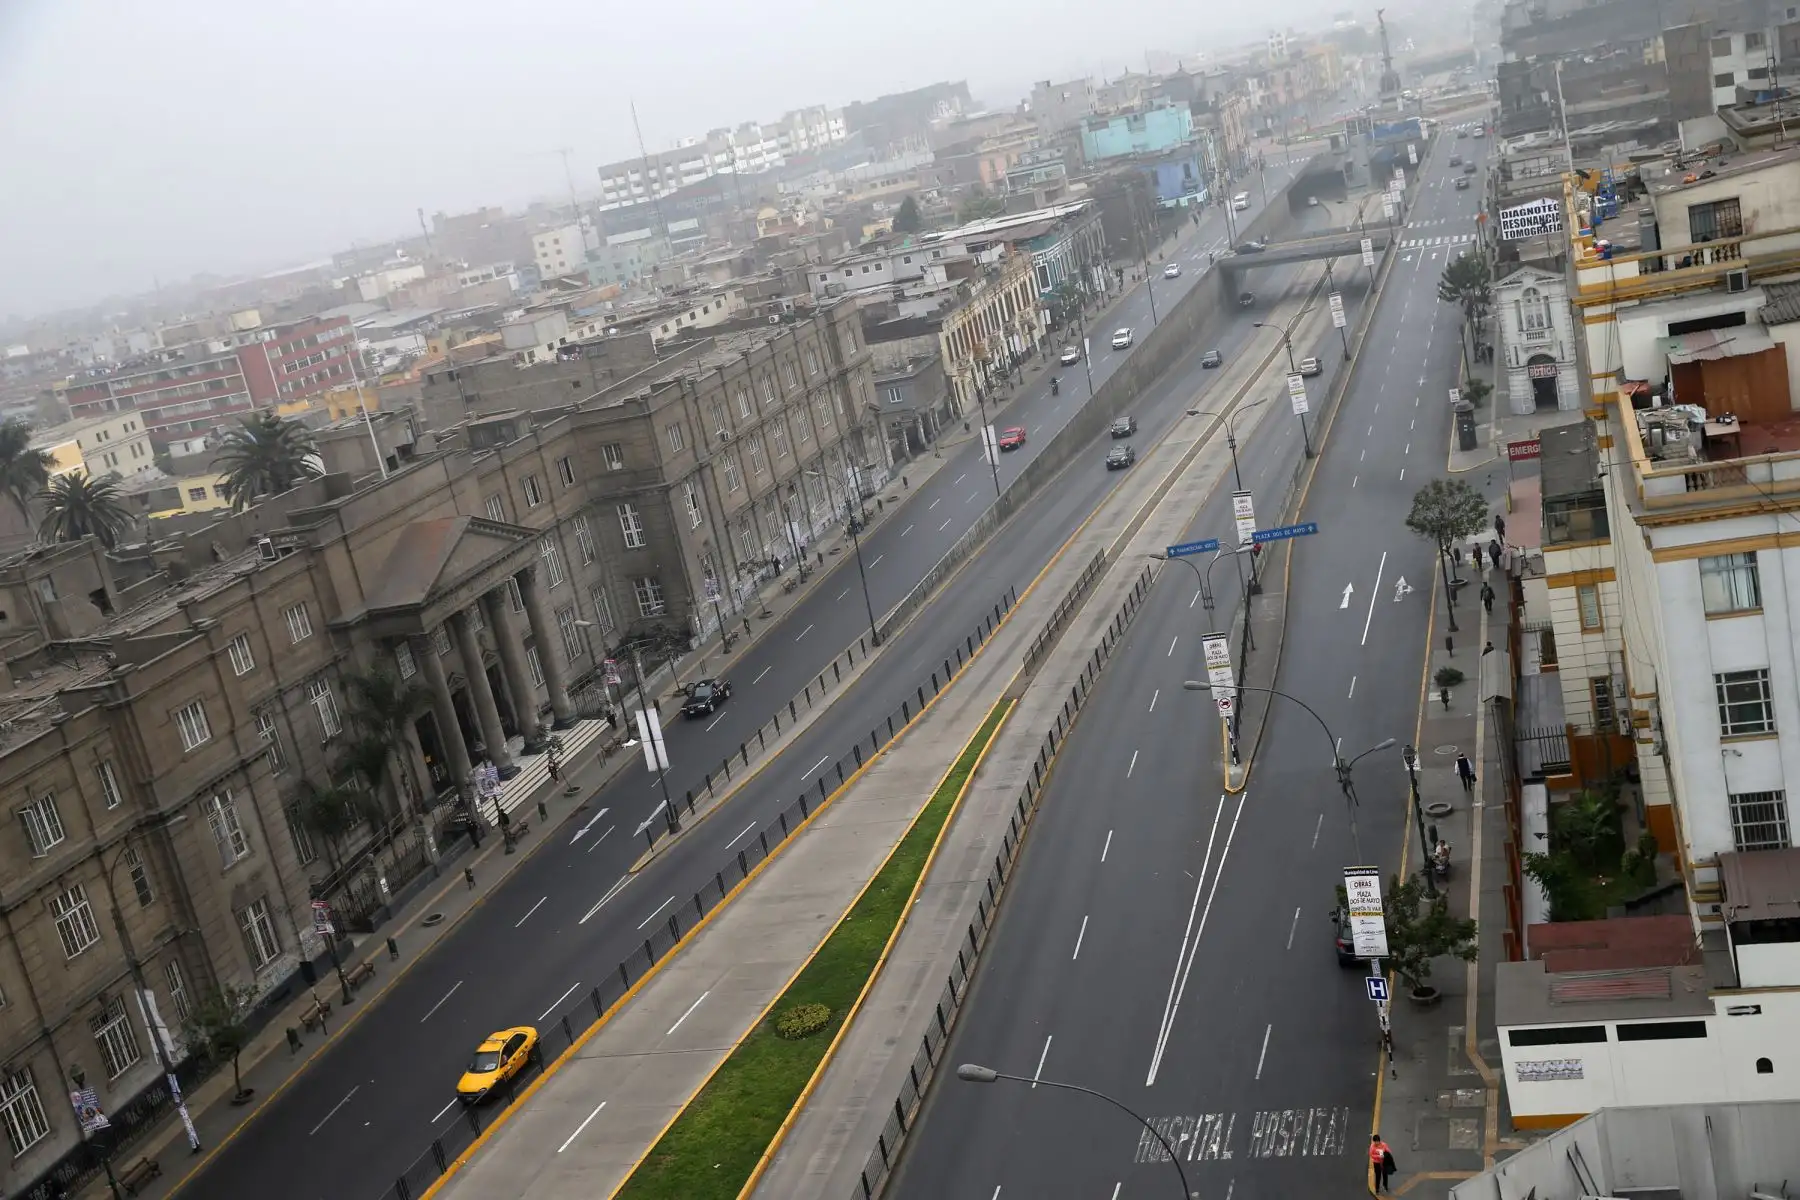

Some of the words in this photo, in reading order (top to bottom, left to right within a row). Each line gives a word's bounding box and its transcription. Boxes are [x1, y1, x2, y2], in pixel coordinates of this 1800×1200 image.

[1501, 203, 1559, 219] DIAGNOTEC
[1353, 880, 1372, 888] OBRAS
[1369, 980, 1385, 997] H
